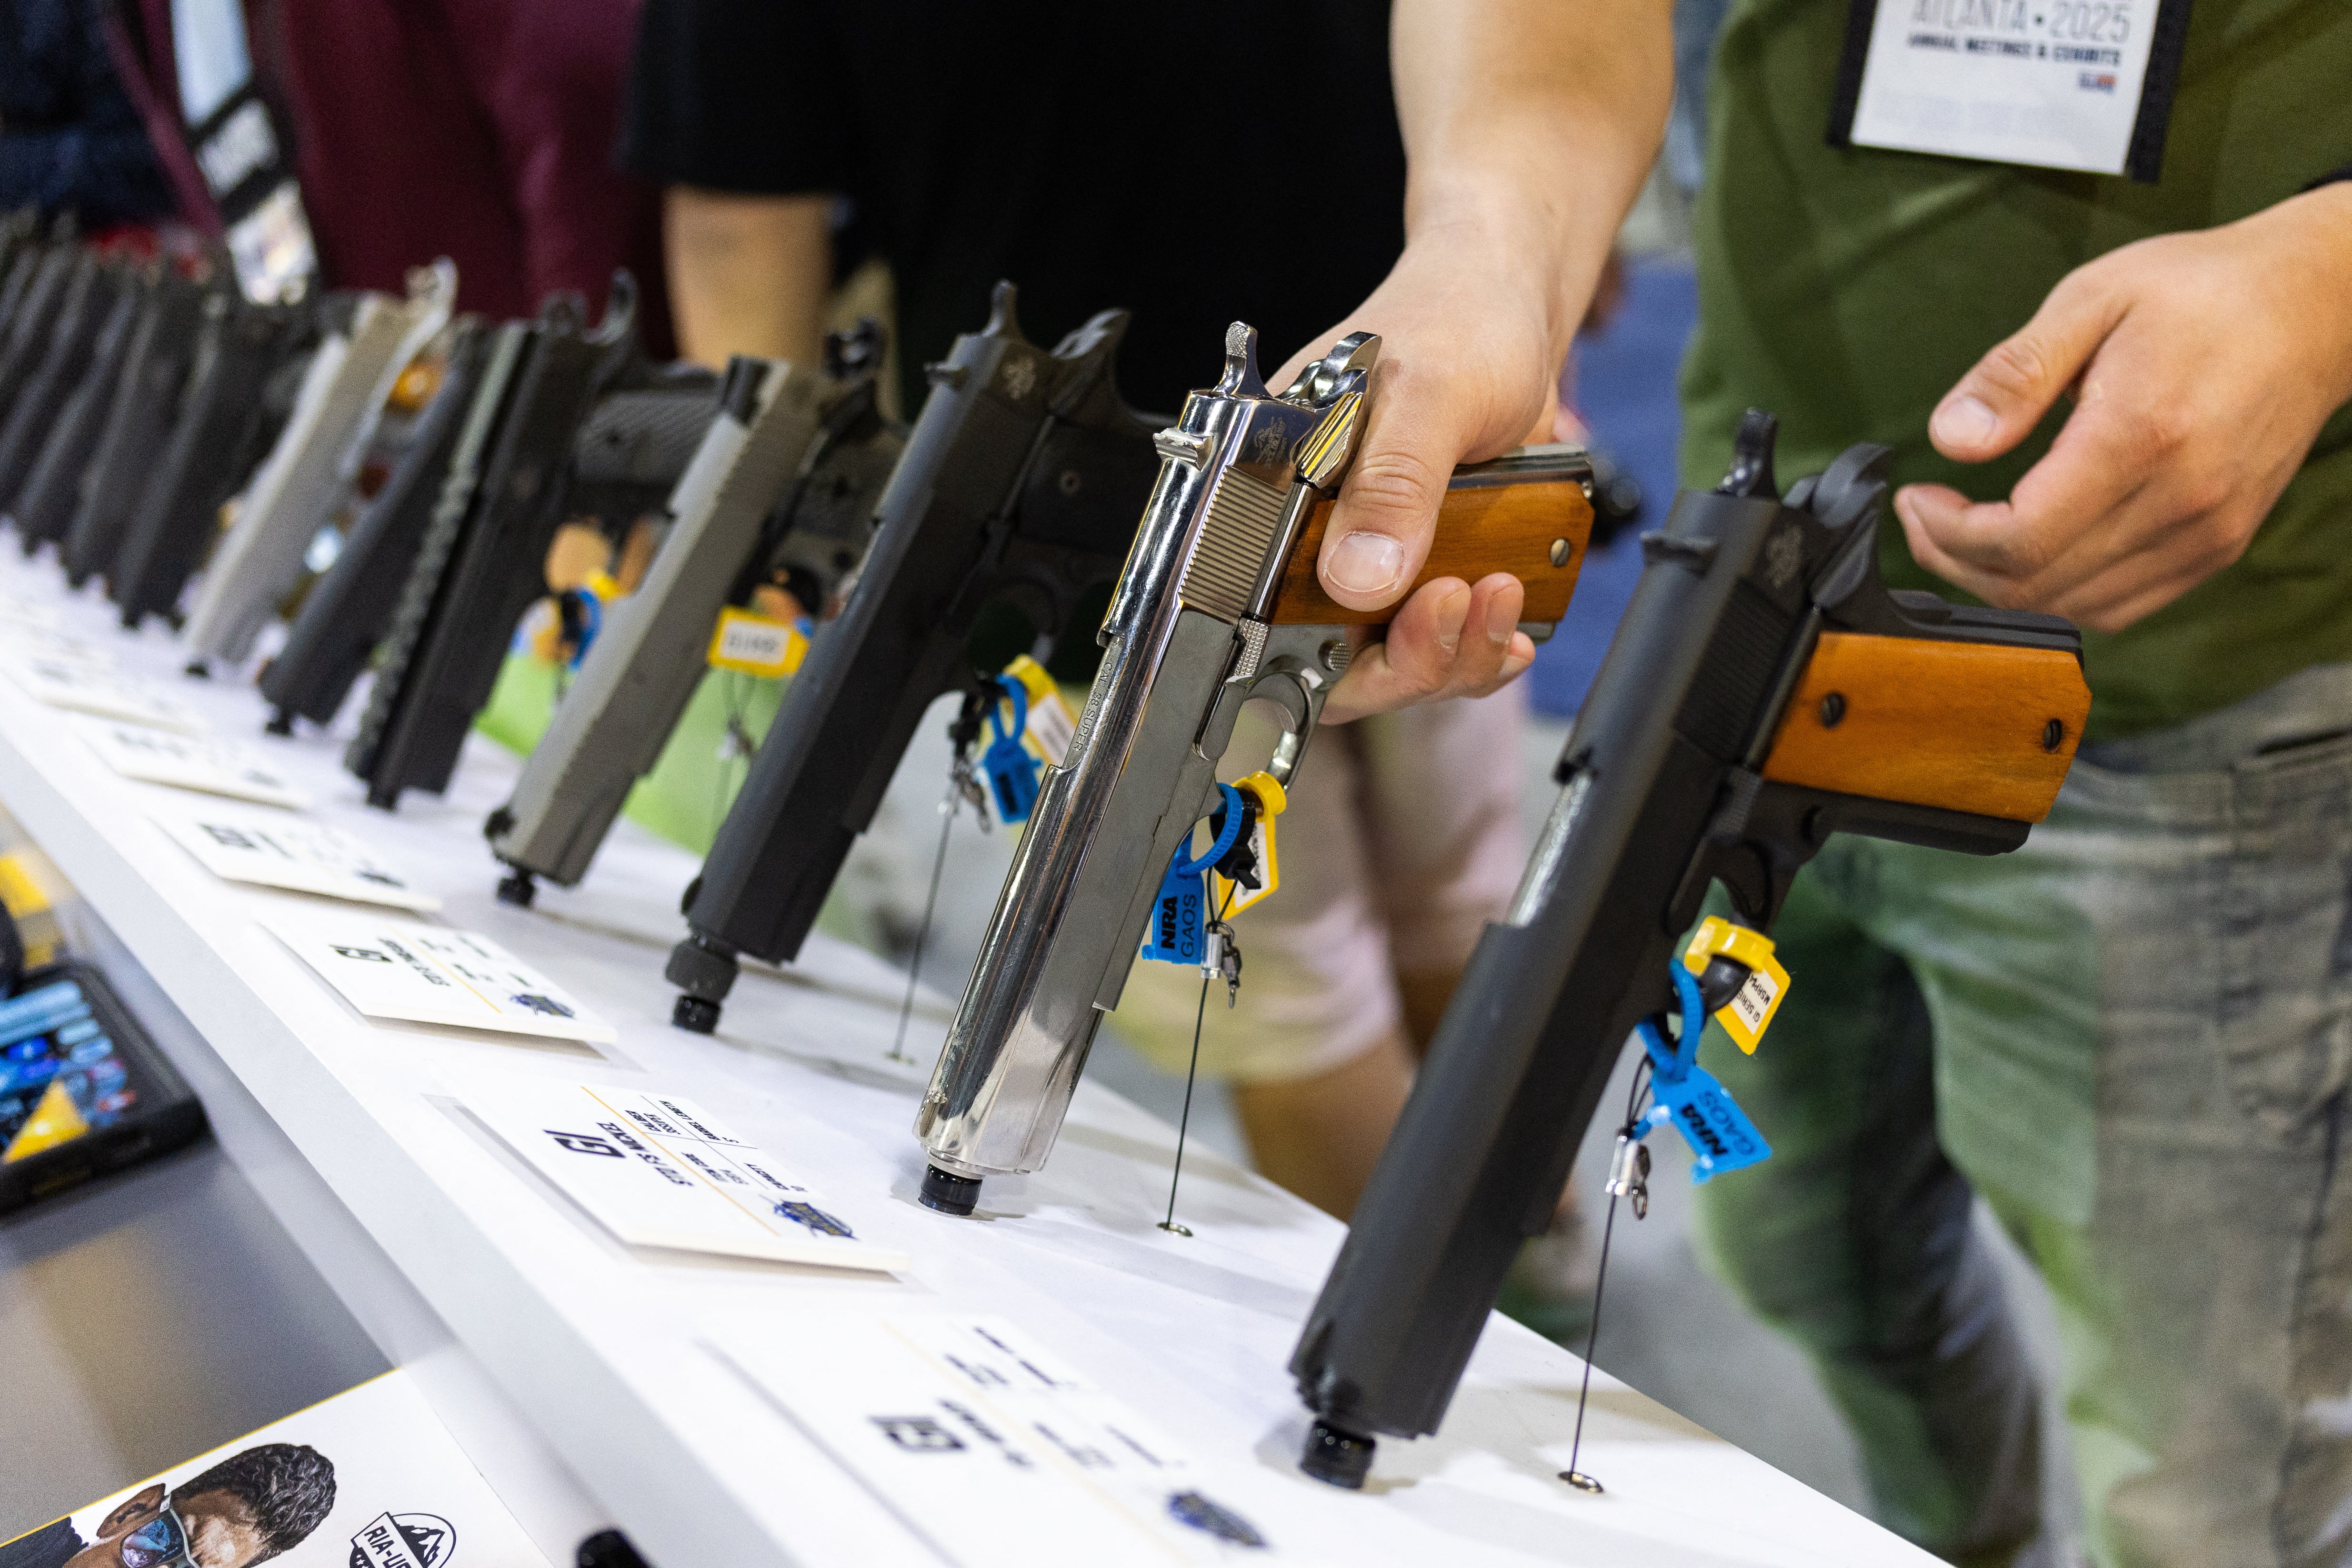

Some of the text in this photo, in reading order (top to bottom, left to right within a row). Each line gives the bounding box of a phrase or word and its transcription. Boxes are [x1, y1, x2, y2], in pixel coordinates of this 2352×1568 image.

[2050, 1, 2131, 43] 2025
[1074, 709, 1095, 751] SUPER
[1161, 896, 1178, 949] NRA
[1181, 894, 1197, 958] GAOS
[1736, 990, 1754, 1014] SERIE
[596, 1122, 649, 1151] NICKEL
[625, 1110, 661, 1131] CALIBER
[659, 1100, 721, 1140] BARREL LENGTH
[1681, 1103, 1728, 1156] NRA
[744, 1163, 790, 1190] CAPACITY
